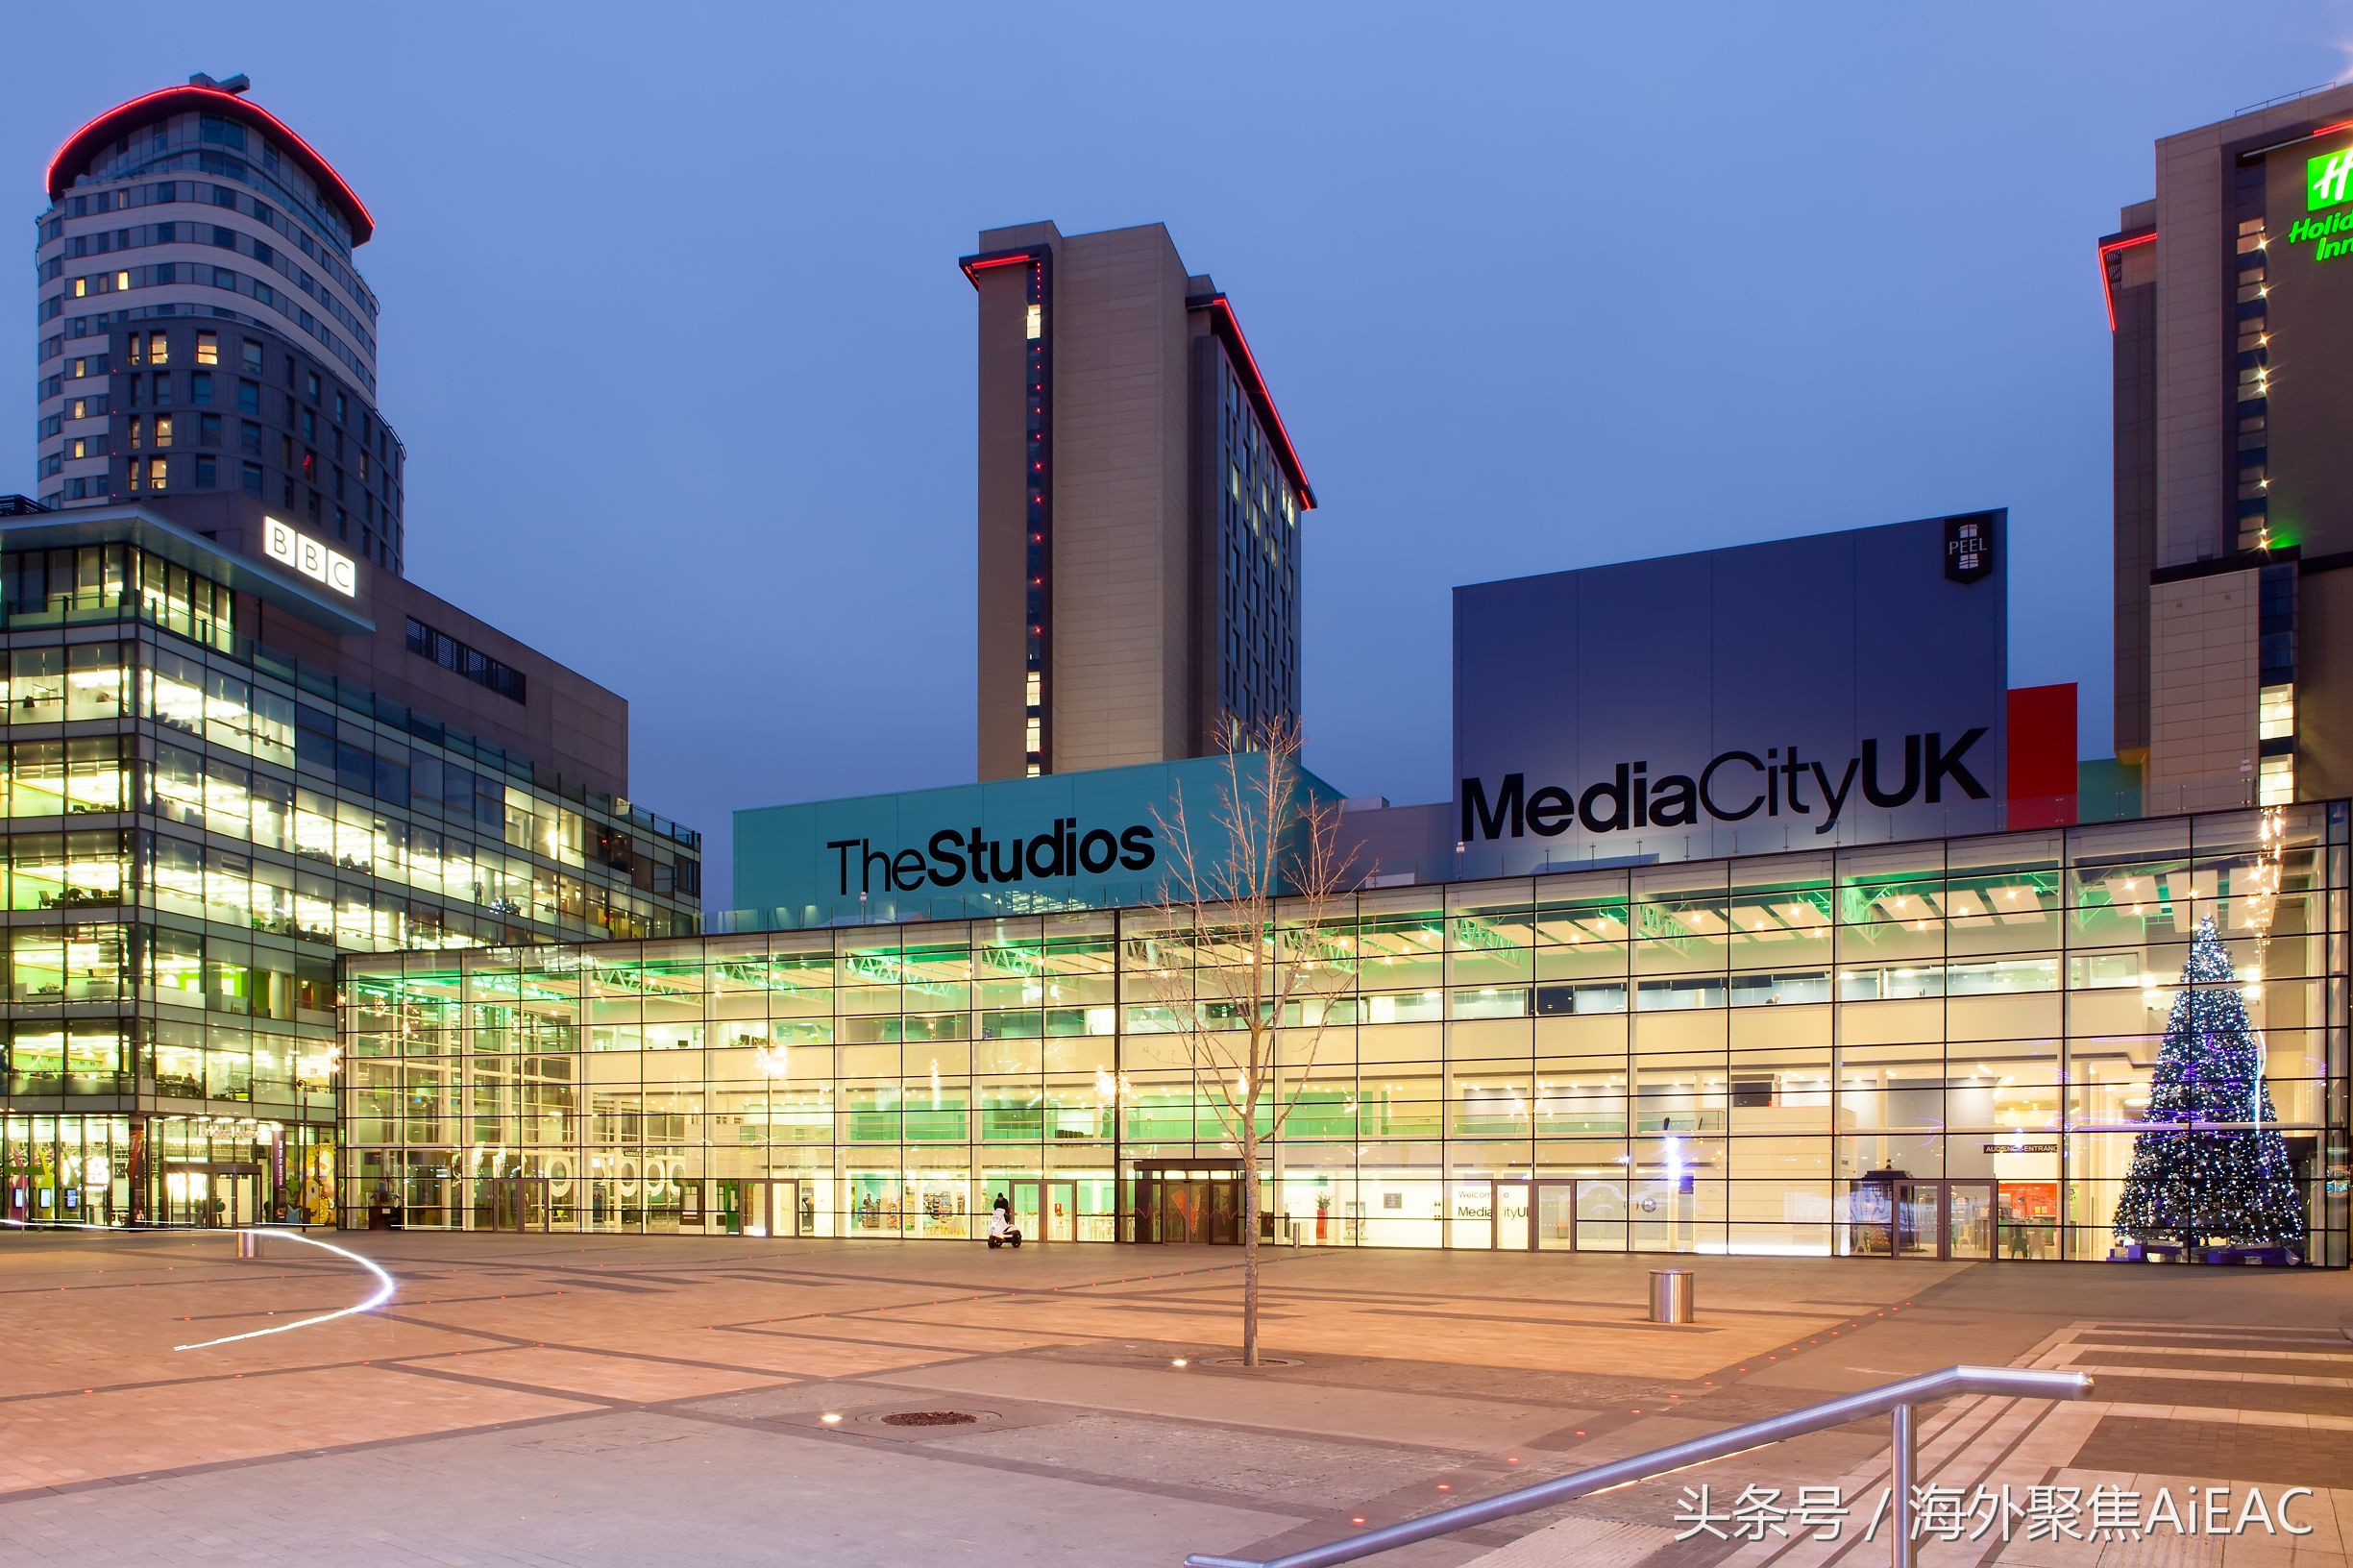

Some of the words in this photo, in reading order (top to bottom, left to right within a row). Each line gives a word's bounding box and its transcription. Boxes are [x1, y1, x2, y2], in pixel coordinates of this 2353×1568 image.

[273, 526, 351, 589] BBC
[1949, 538, 1988, 555] PEEL
[1460, 726, 1991, 842] MediaCityUK
[826, 817, 1156, 895] TheStudios
[1458, 1190, 1491, 1199] Welcom
